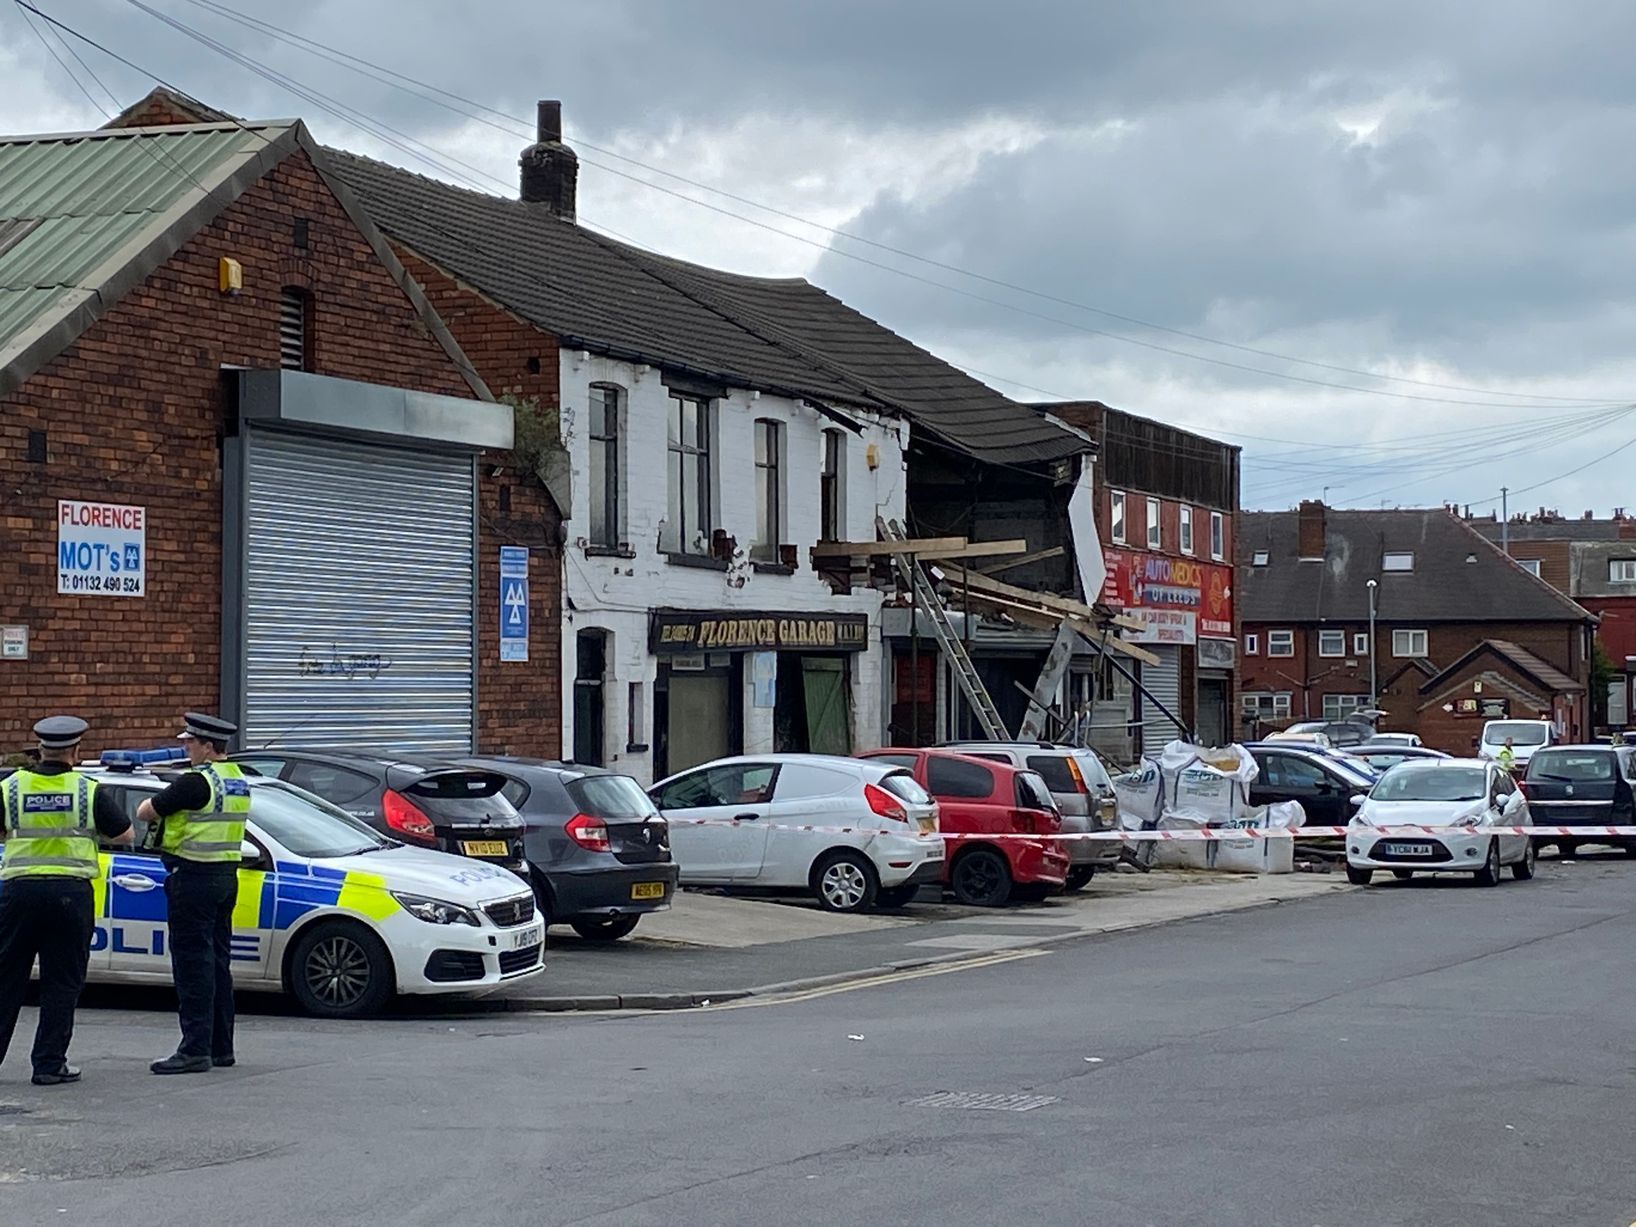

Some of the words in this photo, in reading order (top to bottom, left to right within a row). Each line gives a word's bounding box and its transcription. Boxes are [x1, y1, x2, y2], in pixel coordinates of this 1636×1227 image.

[61, 504, 142, 530] FLORENCE
[61, 541, 120, 573] MOT's
[72, 574, 101, 591] 01132
[103, 576, 121, 592] 490
[123, 577, 140, 593] 524
[697, 620, 775, 647] FLORENCE
[780, 620, 835, 646] GARAGE
[27, 795, 70, 804] POLICE
